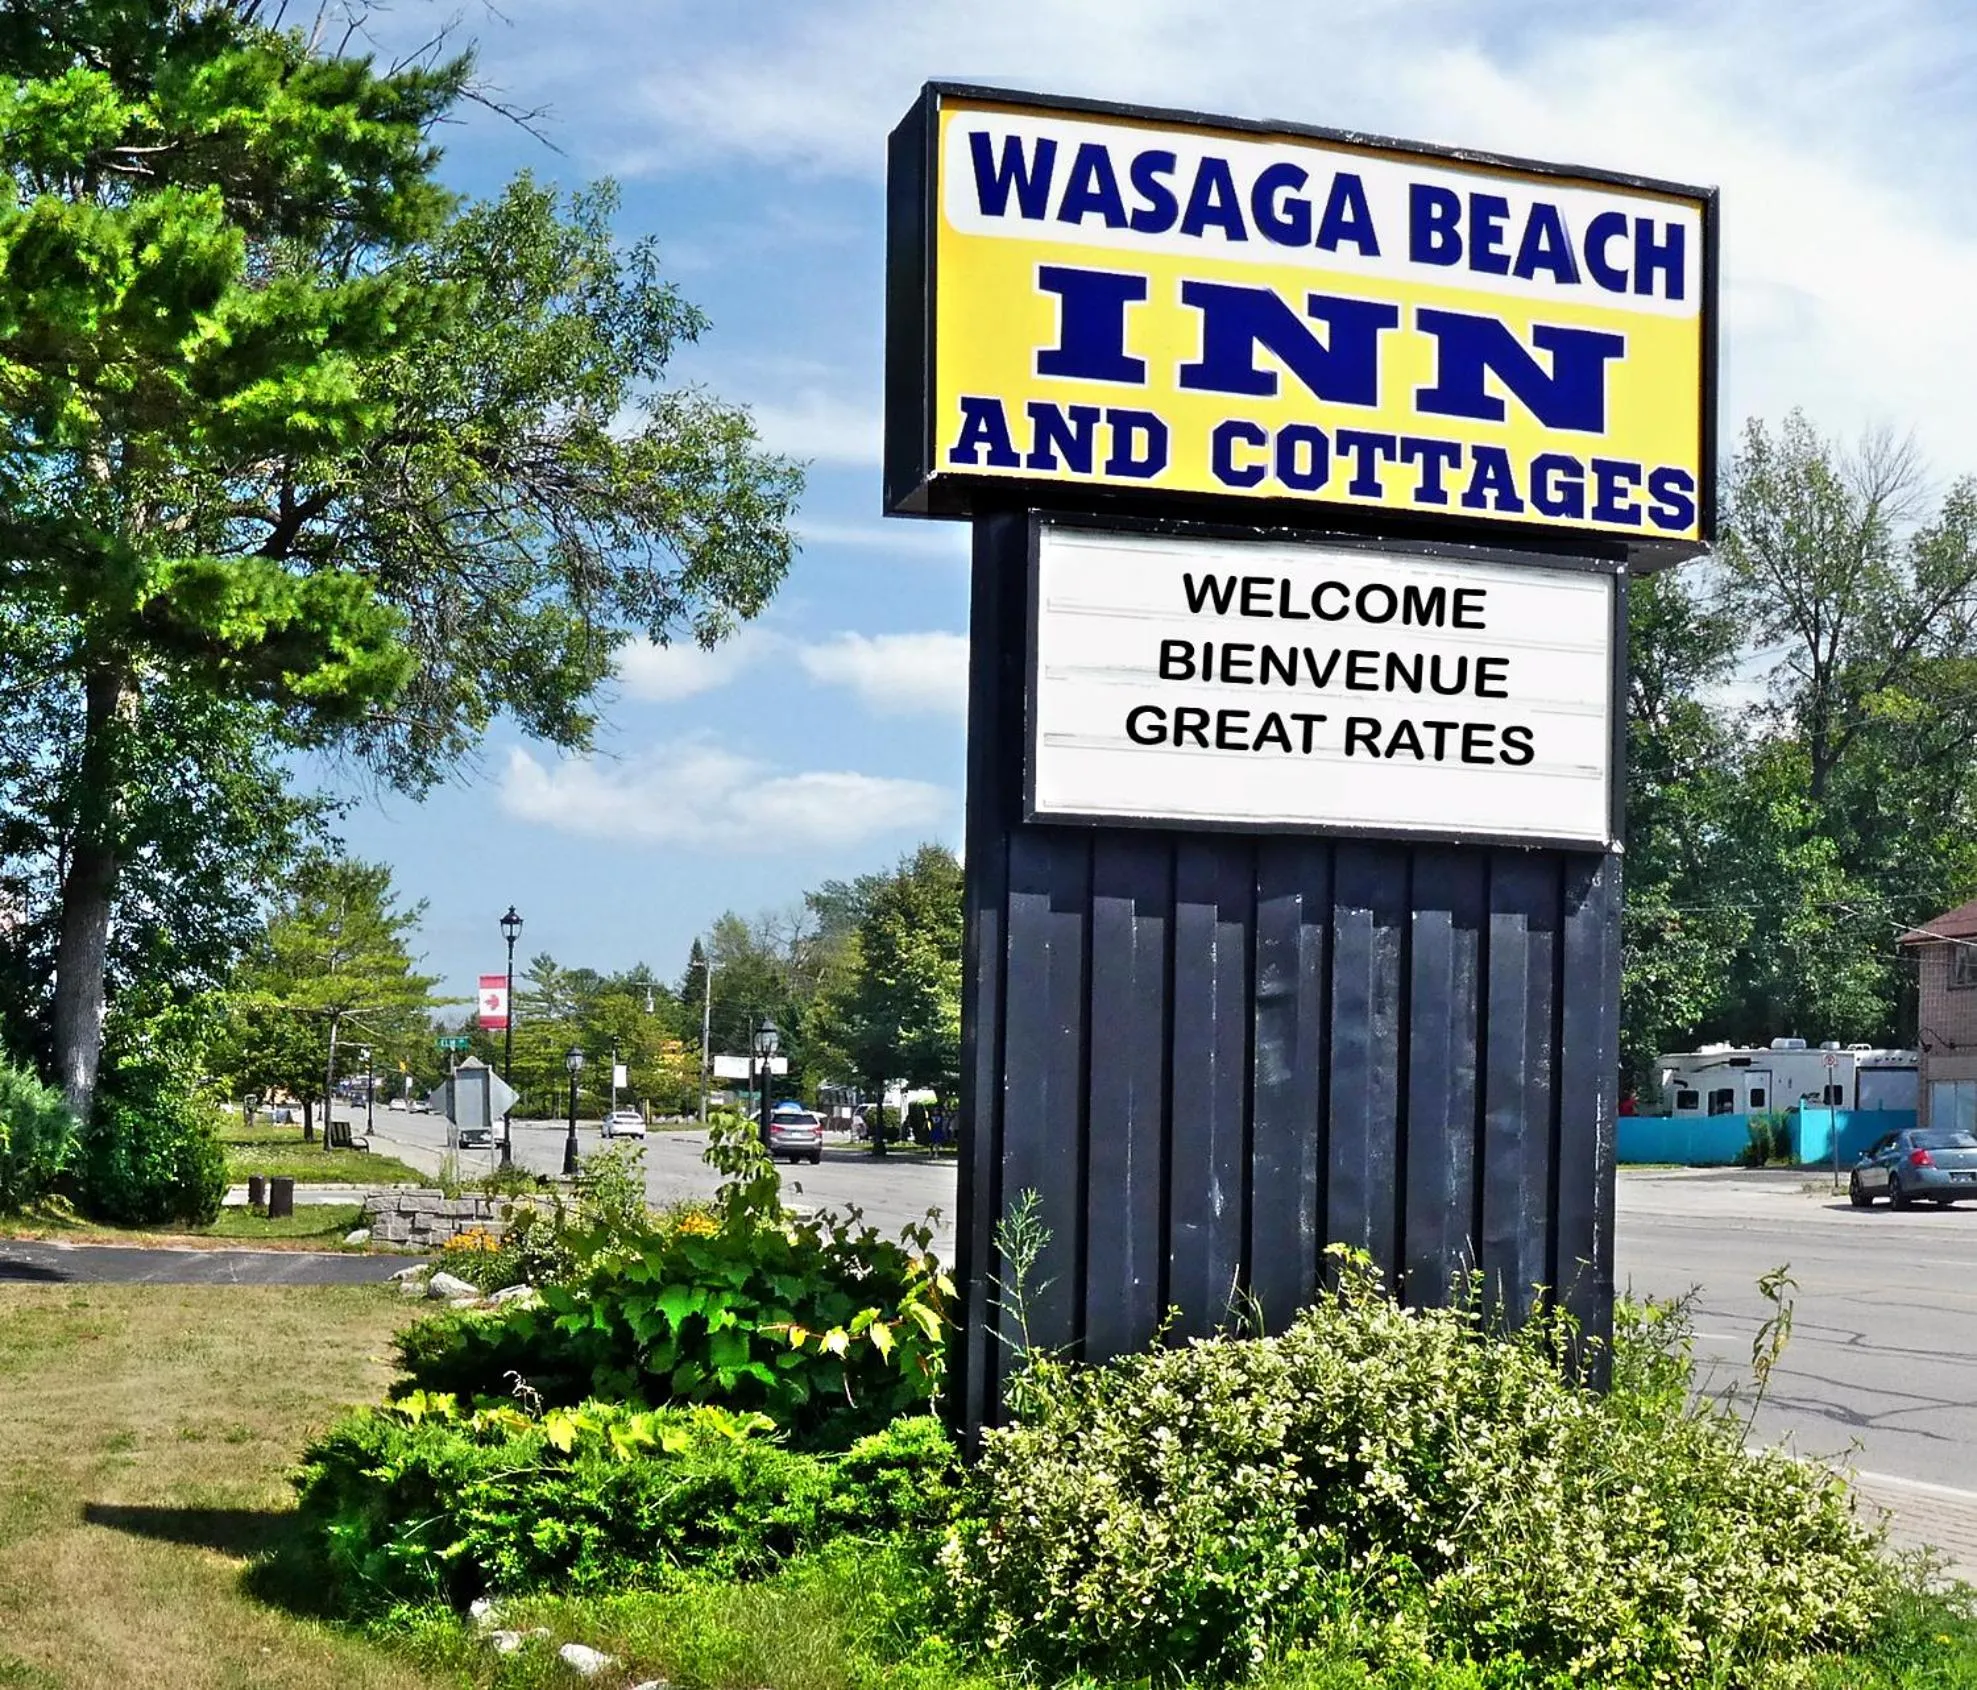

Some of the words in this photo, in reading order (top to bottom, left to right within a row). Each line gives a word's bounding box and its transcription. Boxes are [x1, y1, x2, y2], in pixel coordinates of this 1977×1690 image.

[969, 131, 1381, 257] WASAGA
[1409, 183, 1685, 300] BEACH
[1037, 266, 1625, 433] INN
[949, 397, 1168, 479] AND
[1212, 420, 1695, 531] COTTAGES
[1182, 573, 1487, 630] WELCOME
[1158, 639, 1510, 699] BIENVENUE
[1125, 705, 1328, 755] GREAT
[1344, 716, 1535, 766] RATES
